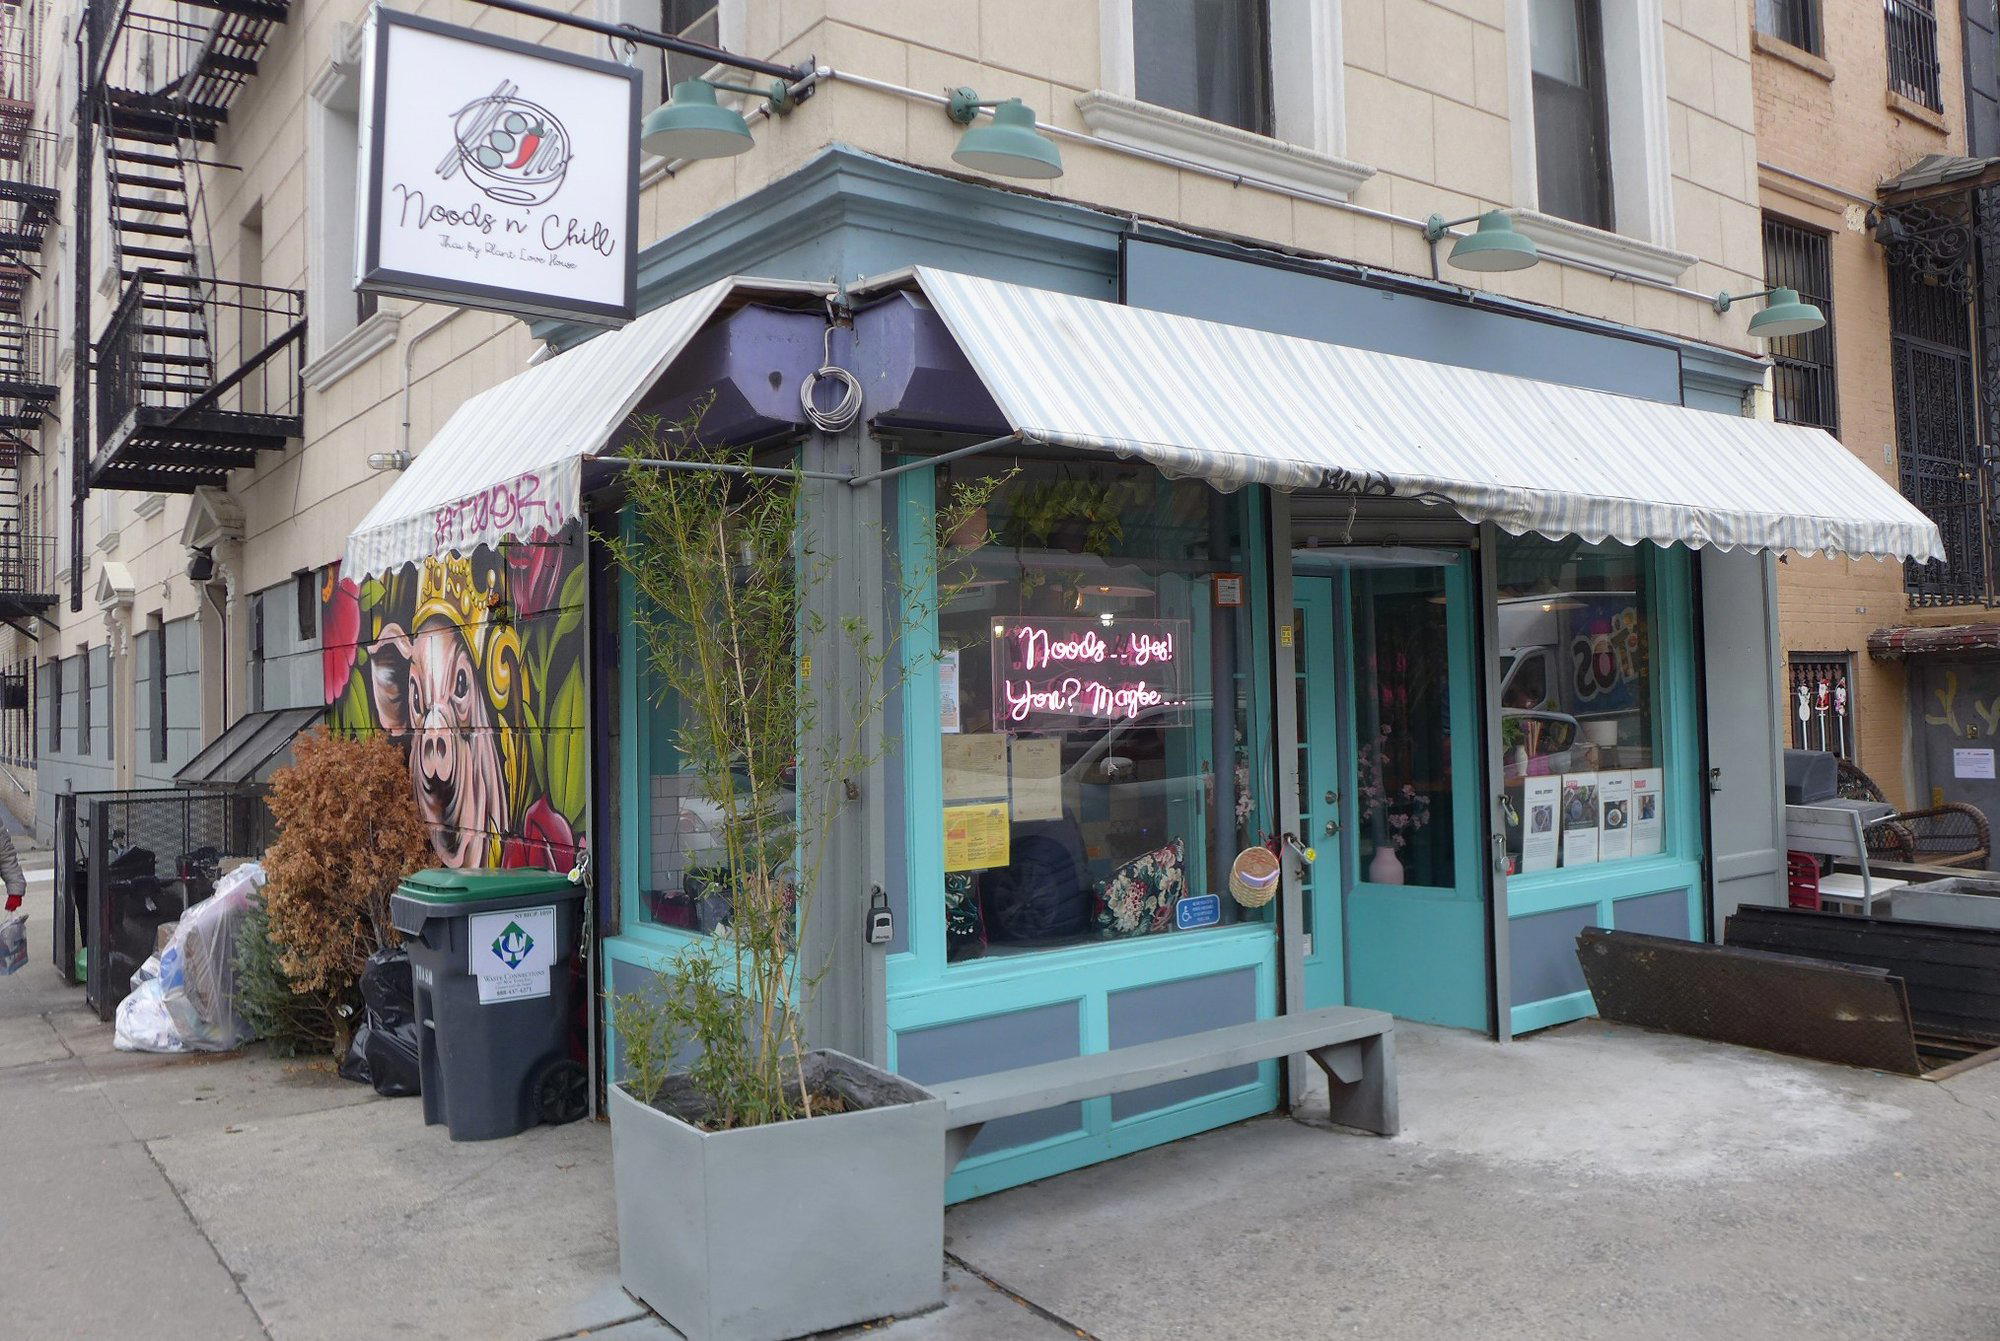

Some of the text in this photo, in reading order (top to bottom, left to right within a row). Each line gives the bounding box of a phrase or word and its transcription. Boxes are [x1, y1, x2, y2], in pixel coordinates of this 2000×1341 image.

[392, 183, 496, 235] Noods
[541, 214, 615, 257] Chill
[466, 240, 480, 259] by
[519, 248, 546, 264] Love
[548, 254, 578, 270] House
[1005, 677, 1082, 721] You?
